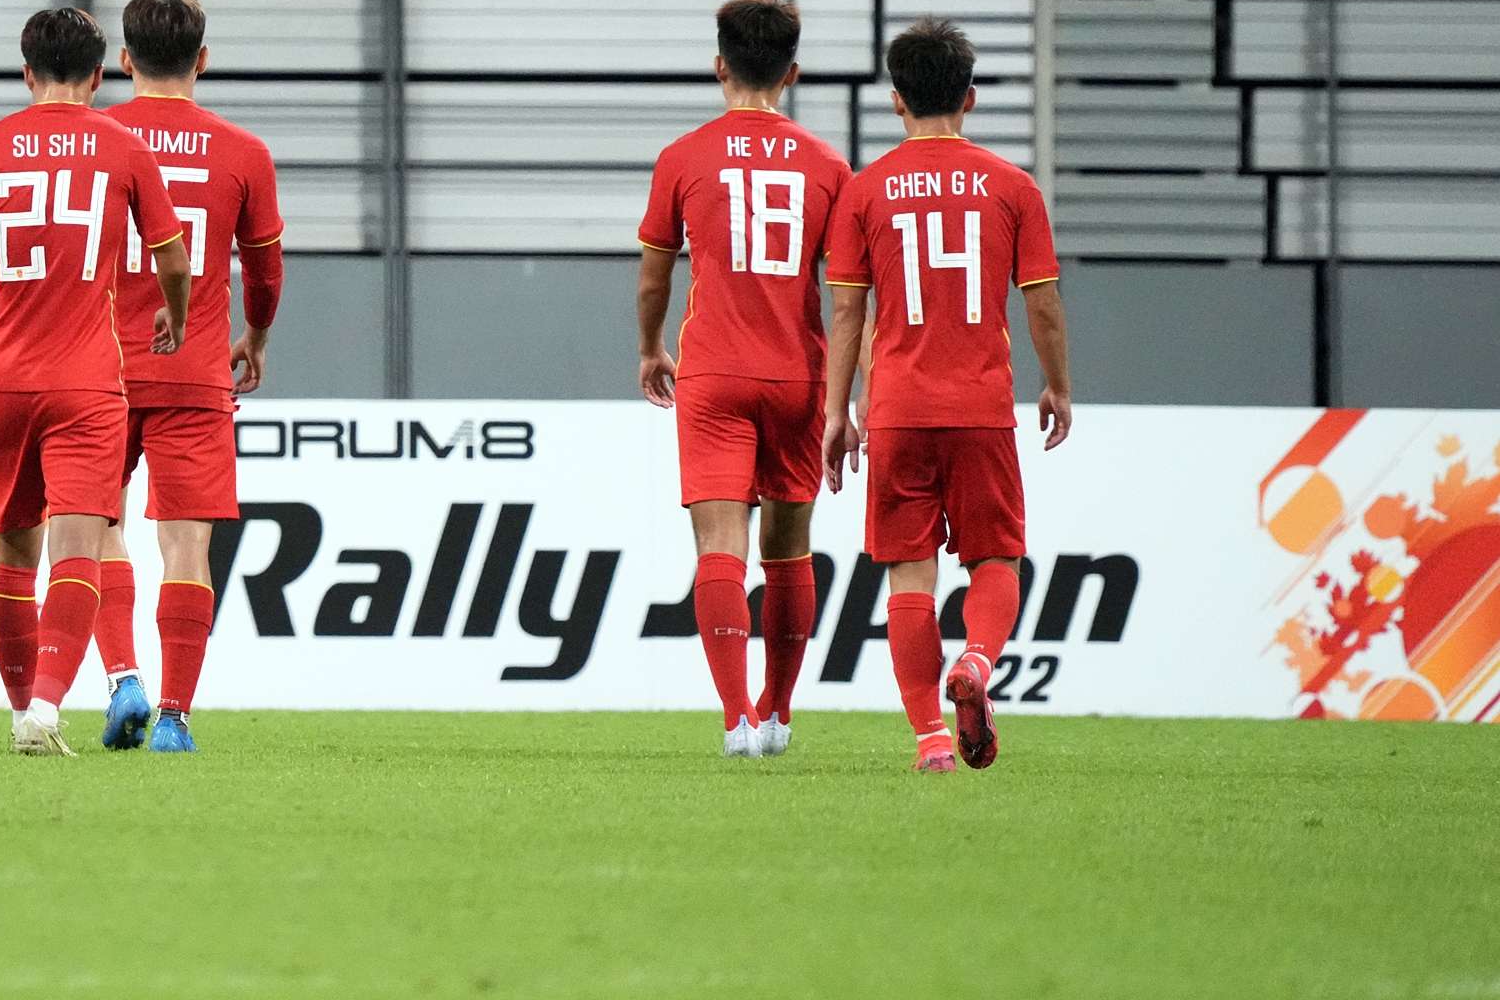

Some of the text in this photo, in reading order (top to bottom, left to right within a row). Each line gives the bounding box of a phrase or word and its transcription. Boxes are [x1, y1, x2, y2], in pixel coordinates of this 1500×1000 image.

[13, 133, 96, 157] SU SH H
[727, 136, 797, 158] HE Y P
[886, 171, 988, 200] CHEN G K
[720, 168, 805, 276] 18
[892, 211, 981, 325] 14
[208, 503, 620, 680] Rally
[939, 655, 1059, 701] 22
